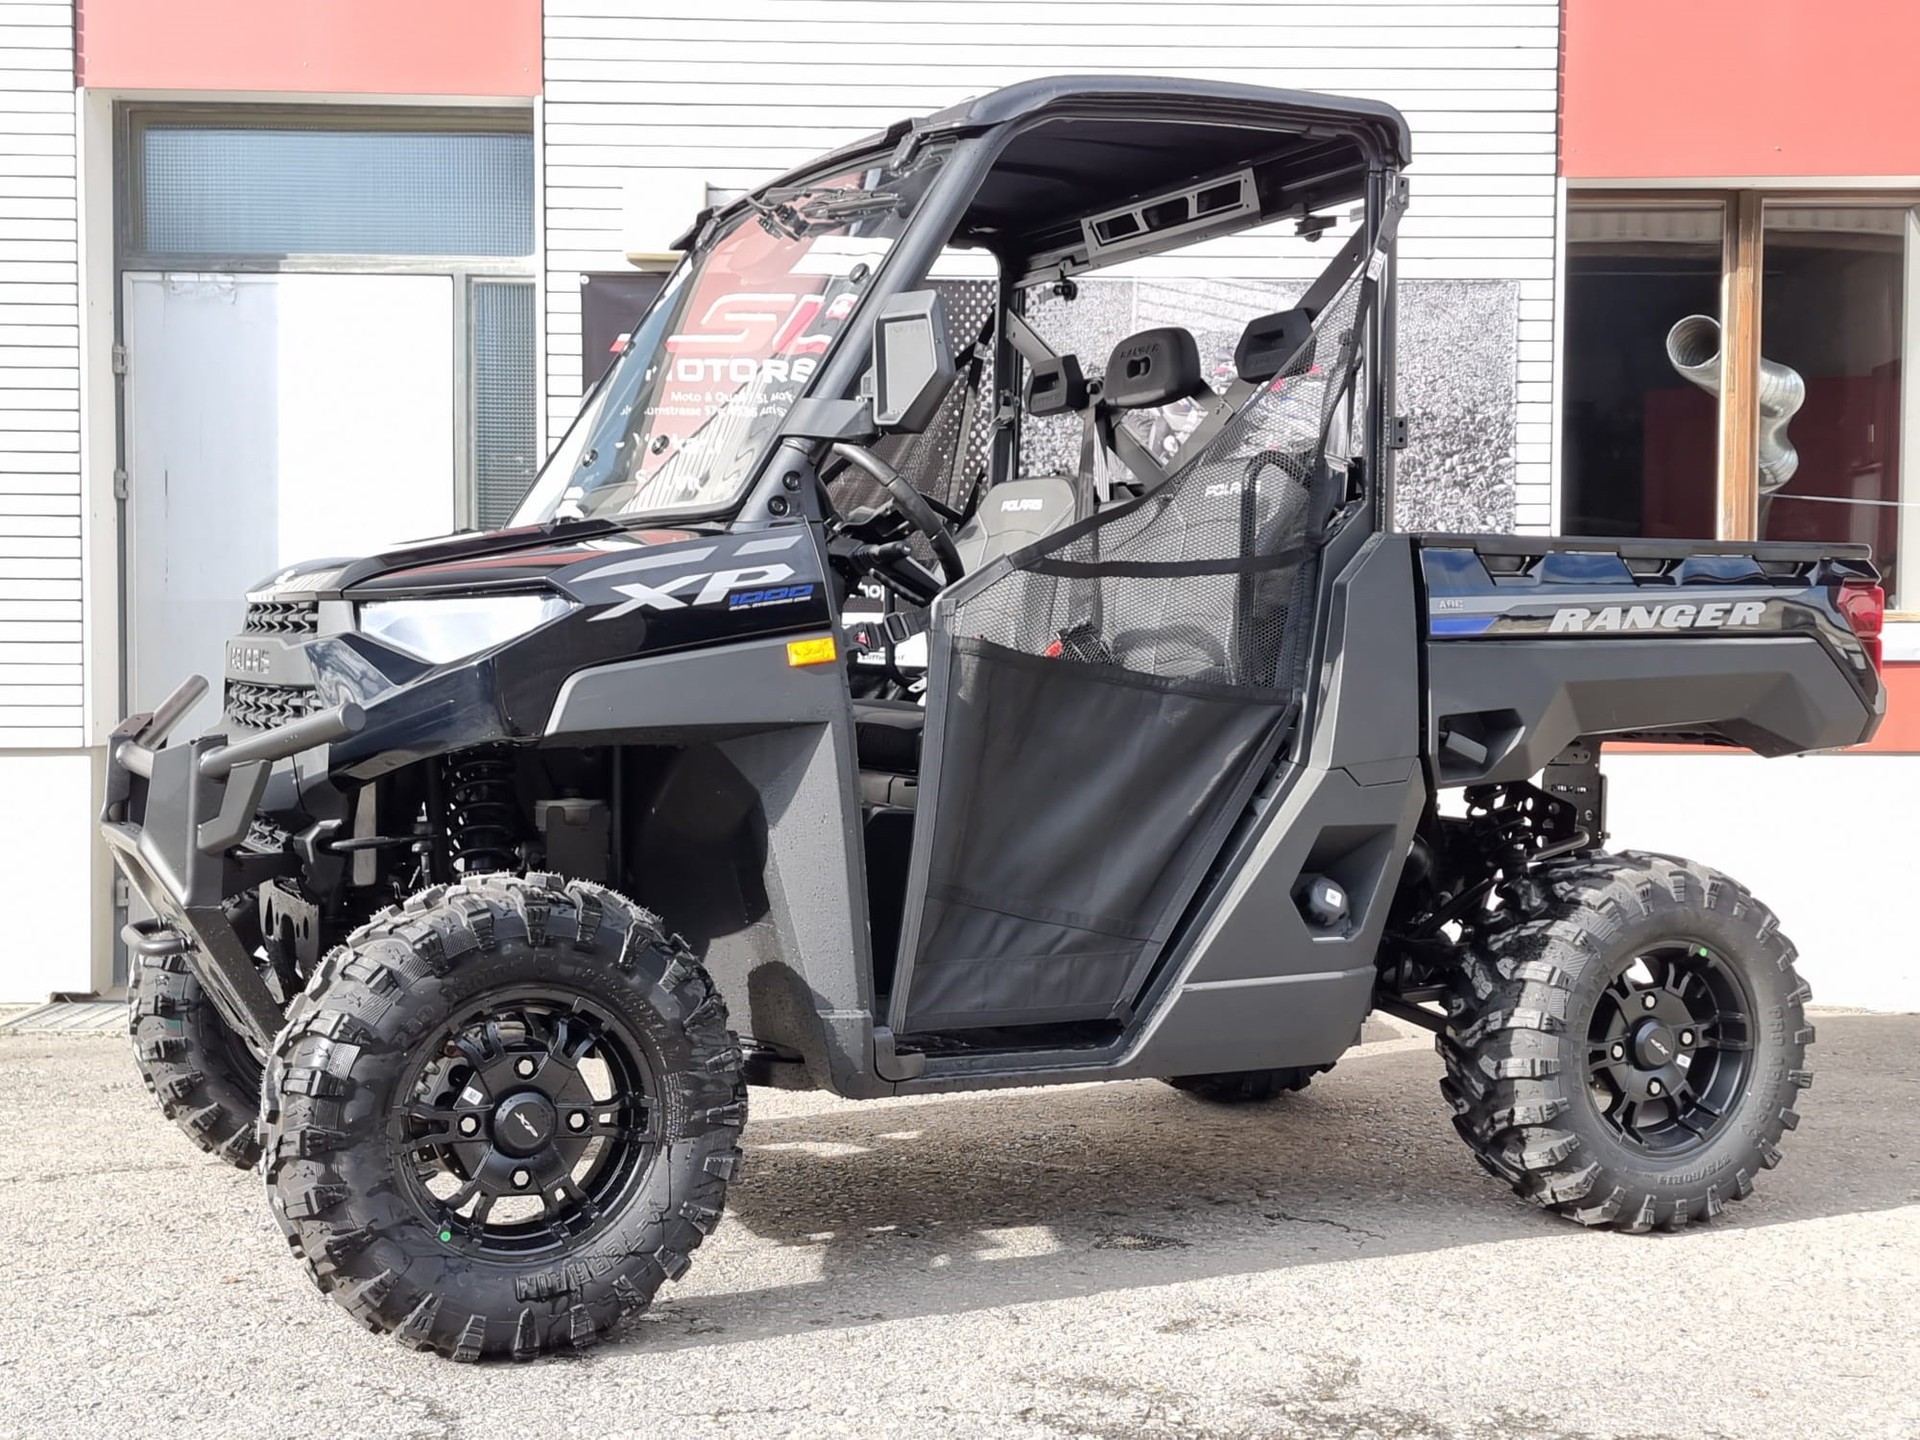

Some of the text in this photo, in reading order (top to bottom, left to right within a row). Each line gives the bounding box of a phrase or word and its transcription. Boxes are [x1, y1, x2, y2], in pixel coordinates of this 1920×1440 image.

[587, 563, 795, 622] XP
[729, 584, 815, 606] 1000
[1549, 601, 1767, 632] RANGER
